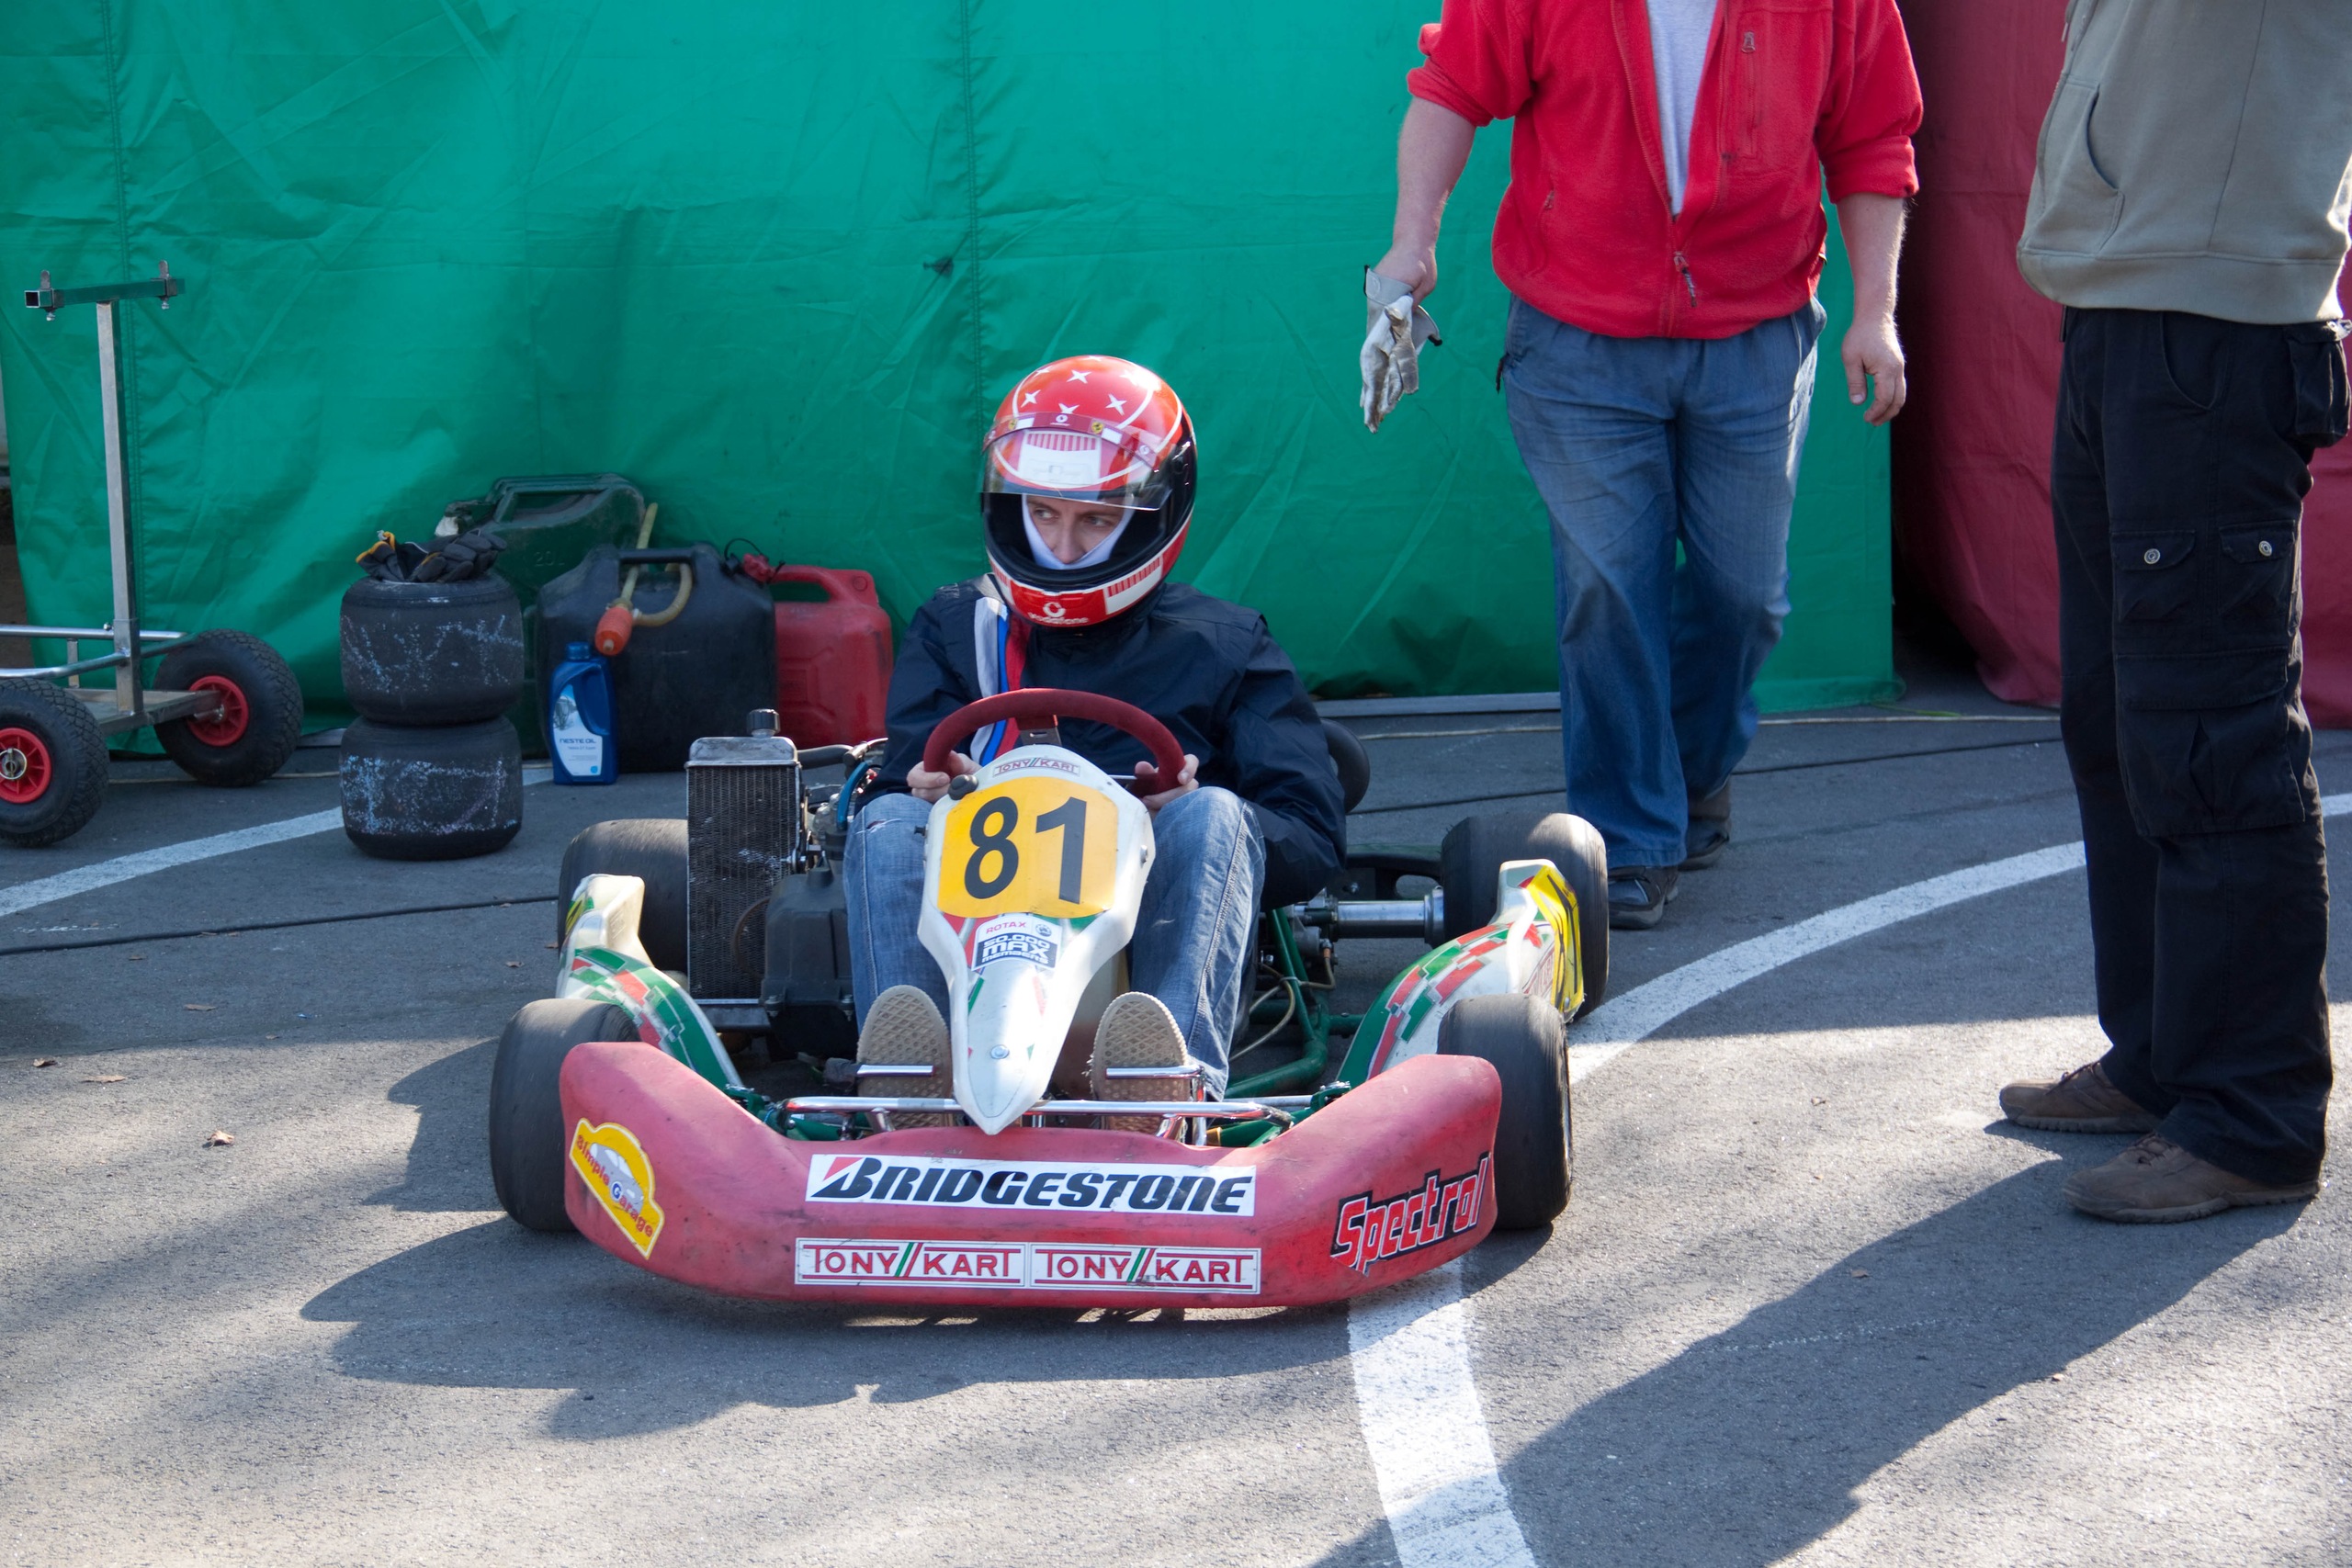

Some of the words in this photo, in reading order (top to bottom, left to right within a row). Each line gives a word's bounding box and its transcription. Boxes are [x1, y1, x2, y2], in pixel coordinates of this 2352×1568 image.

[995, 759, 1031, 773] TONY
[1039, 759, 1080, 774] KART
[964, 795, 1087, 905] 81
[986, 921, 1026, 934] ROTAX
[576, 1134, 610, 1186] Simple
[612, 1182, 653, 1238] Garage
[810, 1156, 1253, 1213] BRIDGESTONE
[1330, 1156, 1488, 1275] Spectrol
[803, 1245, 899, 1274] TONY
[923, 1247, 1021, 1277] KART
[1035, 1248, 1132, 1280] TONY
[1155, 1252, 1253, 1283] KART
